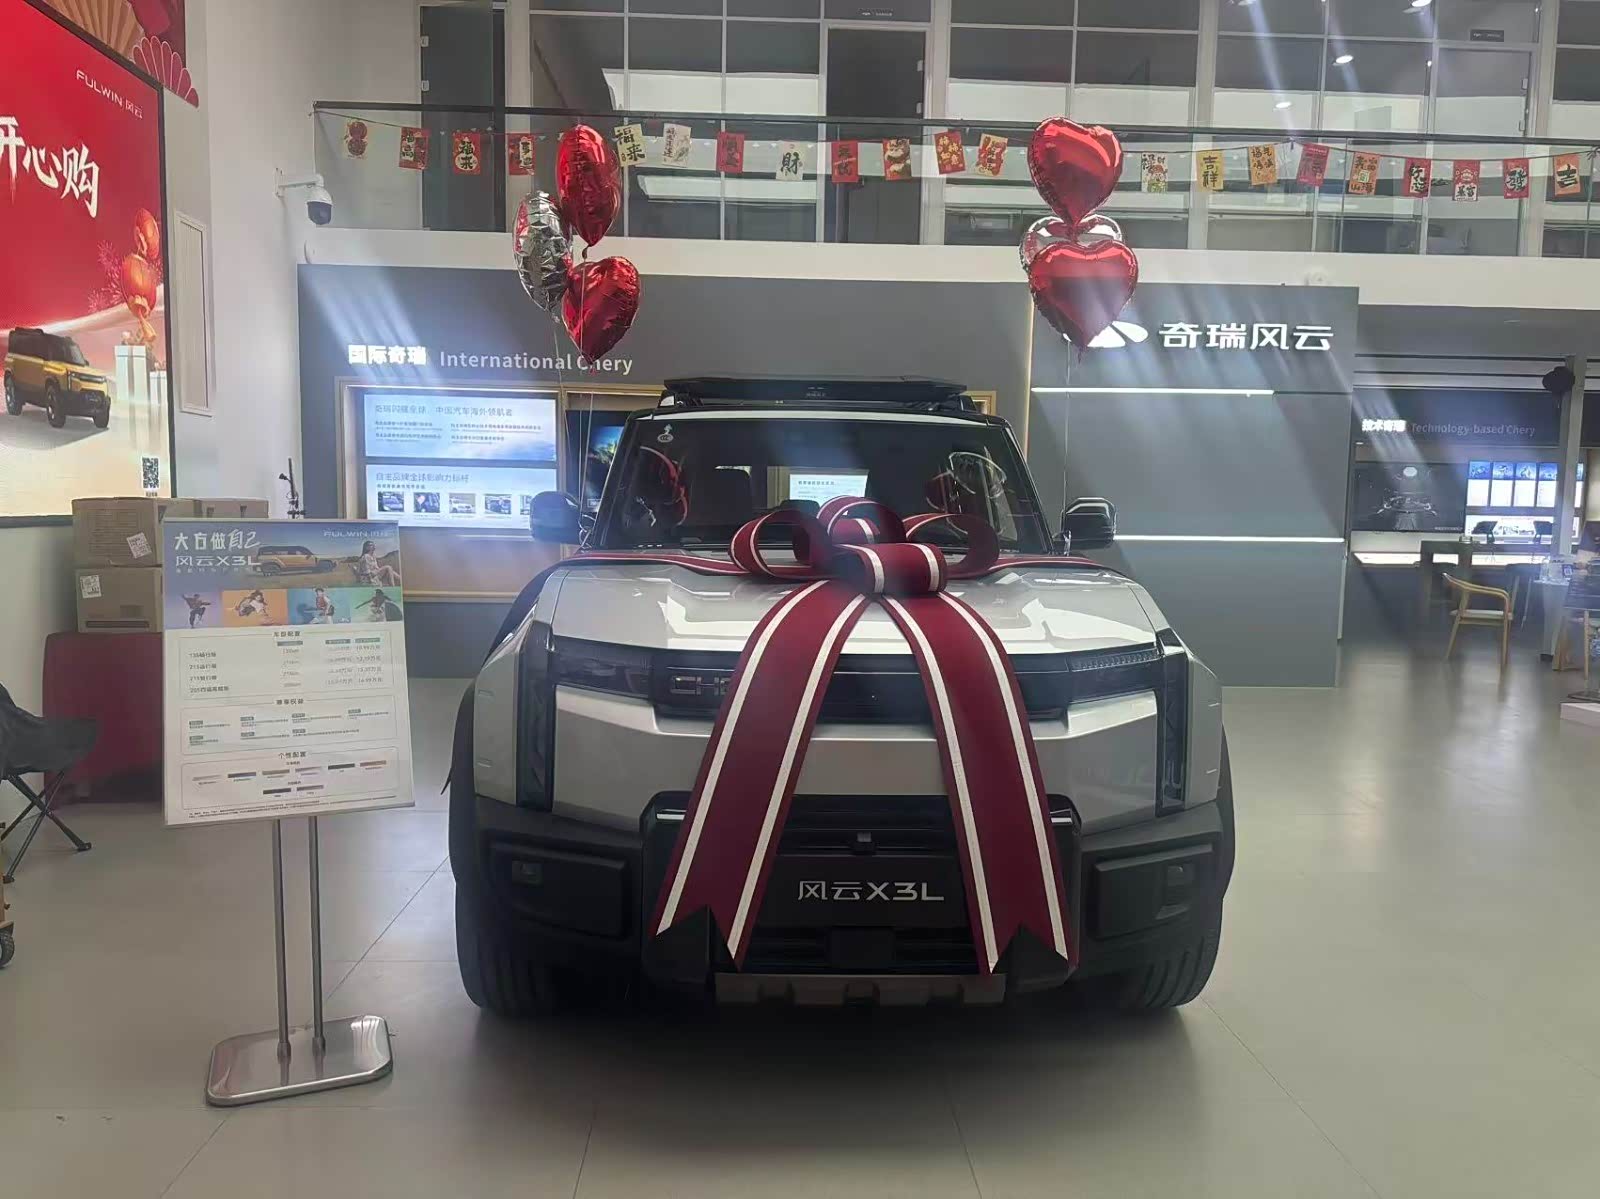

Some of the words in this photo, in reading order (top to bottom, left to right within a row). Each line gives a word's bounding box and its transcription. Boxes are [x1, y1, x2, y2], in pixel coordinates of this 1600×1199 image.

[75, 69, 122, 107] FULWIN
[614, 126, 646, 162] 福来
[0, 115, 100, 218] 开心购
[1202, 155, 1219, 188] 吉祥
[1158, 322, 1334, 351] 奇瑞风云
[440, 351, 572, 371] International
[1506, 424, 1535, 437] Chery
[174, 528, 261, 551] 大方做自己
[176, 555, 262, 567] 风云X3L
[798, 880, 945, 902] 风云X3L
